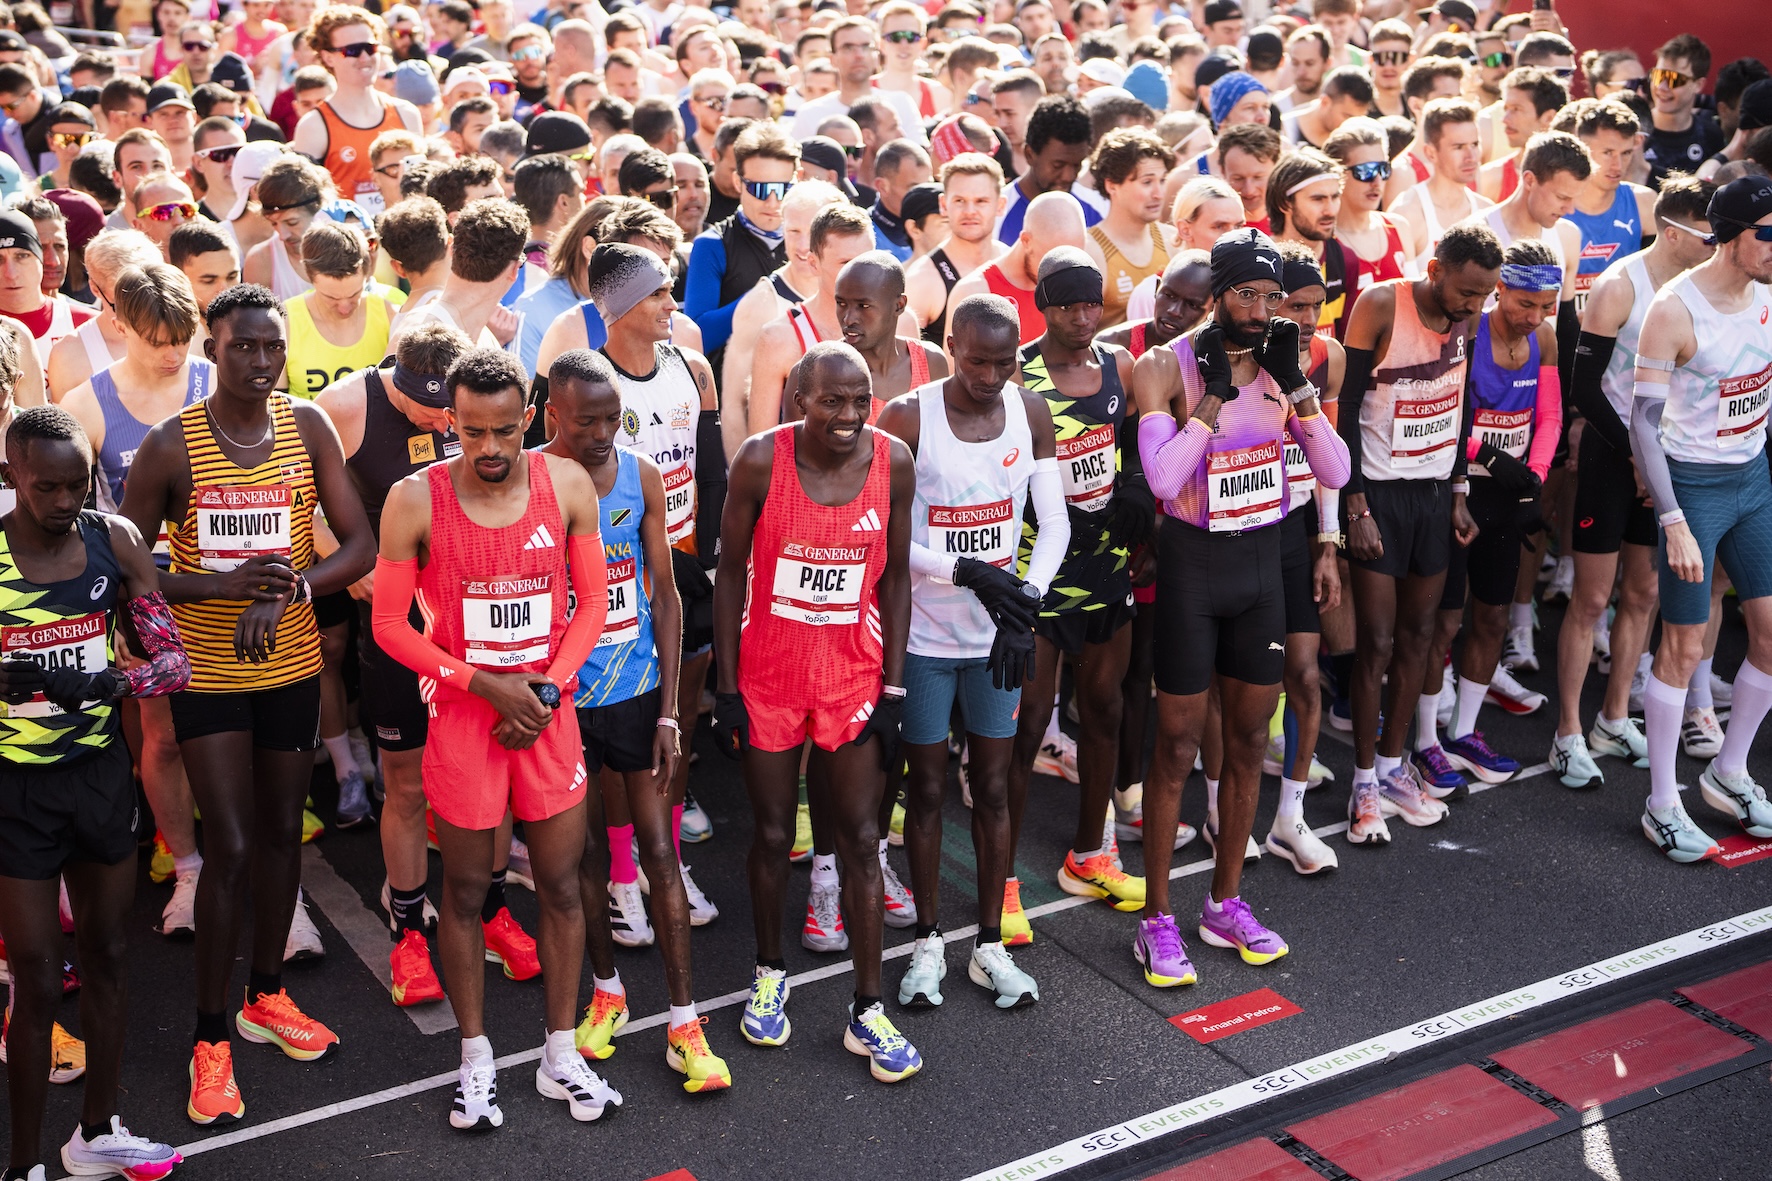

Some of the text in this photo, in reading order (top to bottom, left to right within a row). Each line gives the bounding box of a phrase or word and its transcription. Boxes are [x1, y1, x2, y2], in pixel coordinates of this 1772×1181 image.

[939, 261, 957, 281] soar
[1513, 379, 1537, 388] KIPRUN
[1416, 394, 1457, 415] GENERALI
[1728, 385, 1769, 417] RICHARD
[1403, 416, 1453, 438] WELDEZGHI
[1494, 409, 1531, 427] GENERALI
[1069, 429, 1113, 454] GENERALI
[1481, 430, 1525, 449] AMANIEL
[1230, 445, 1277, 467] GENERALI
[1071, 452, 1107, 484] PACE
[1219, 467, 1275, 498] AMANAL
[222, 490, 287, 505] GENERALI
[1086, 499, 1108, 510] YoPRO
[209, 512, 281, 536] KIBIWOT
[952, 503, 1010, 523] GENERALI
[243, 541, 252, 549] 60
[945, 525, 1001, 553] KOECH
[804, 546, 866, 560] GENERALI
[488, 576, 550, 595] GENERALI
[799, 565, 848, 592] PACE
[489, 601, 531, 629] DIDA
[804, 614, 830, 623] YoPRO
[31, 618, 101, 644] GENERALI
[510, 632, 515, 641] 2
[32, 645, 86, 673] PACE
[498, 654, 526, 664] YoPRO
[1721, 847, 1761, 861] Richard
[1698, 926, 1736, 942] SCC
[1559, 945, 1678, 989] SCC EVENTS
[1202, 1016, 1246, 1034] Amanal
[1243, 1005, 1282, 1020] Petros
[1411, 992, 1537, 1039] SCC EVENTS
[265, 1021, 314, 1042] KIPRUN
[1252, 1043, 1387, 1093] SCC EVENTS
[1081, 1098, 1225, 1152] SCC EVENTS
[986, 1155, 1065, 1181] ENTS
